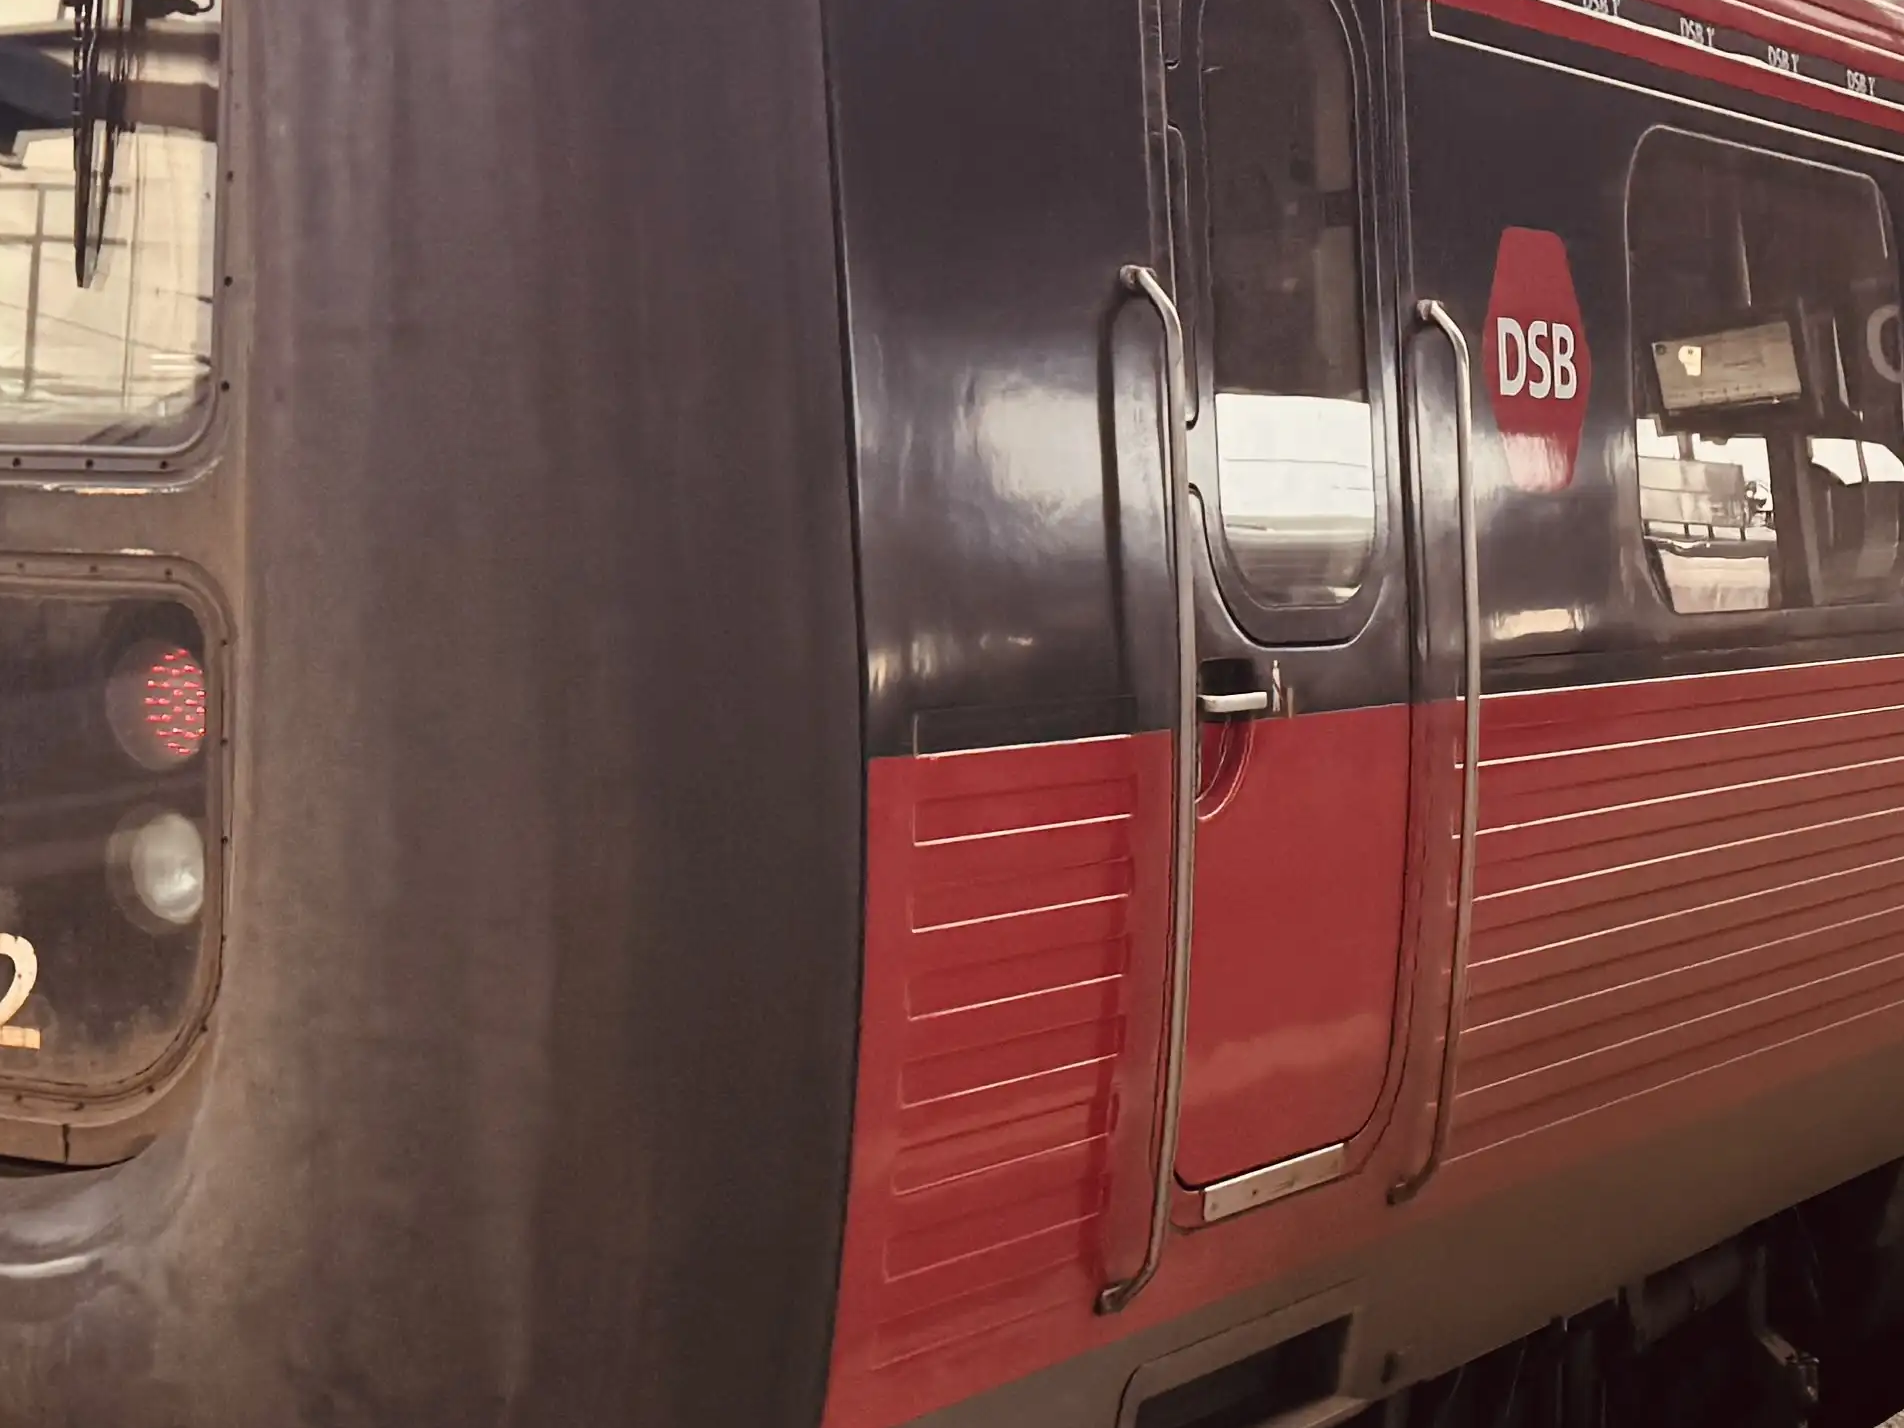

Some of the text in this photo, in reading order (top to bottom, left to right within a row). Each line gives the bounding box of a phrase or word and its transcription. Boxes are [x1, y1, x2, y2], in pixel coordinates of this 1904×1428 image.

[1680, 17, 1705, 45] DSB
[1768, 45, 1790, 71] DSB
[1497, 317, 1578, 400] DSB
